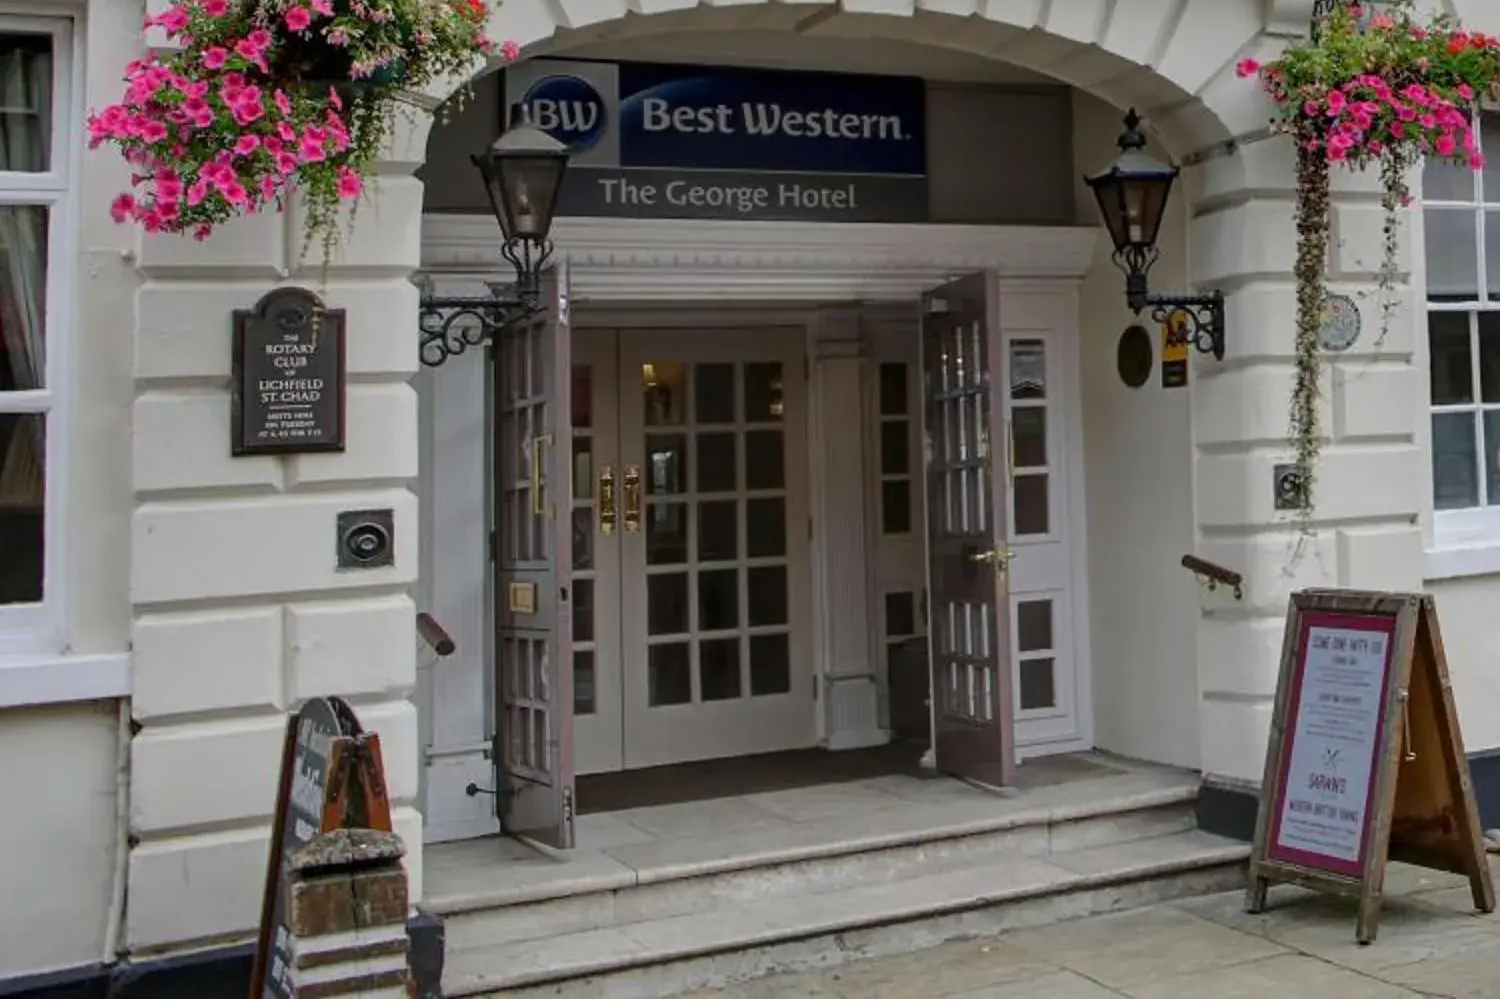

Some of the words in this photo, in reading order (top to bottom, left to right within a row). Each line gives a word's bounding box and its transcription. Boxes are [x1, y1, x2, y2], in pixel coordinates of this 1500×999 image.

[533, 98, 598, 132] BW
[643, 98, 734, 134] Best
[741, 102, 903, 139] Western
[598, 178, 656, 205] The
[665, 179, 768, 211] George
[778, 183, 856, 209] Hotel
[265, 344, 315, 354] ROTARY
[273, 356, 308, 368] CLUB
[259, 379, 323, 391] LICHFIELD
[281, 391, 321, 402] CHAD
